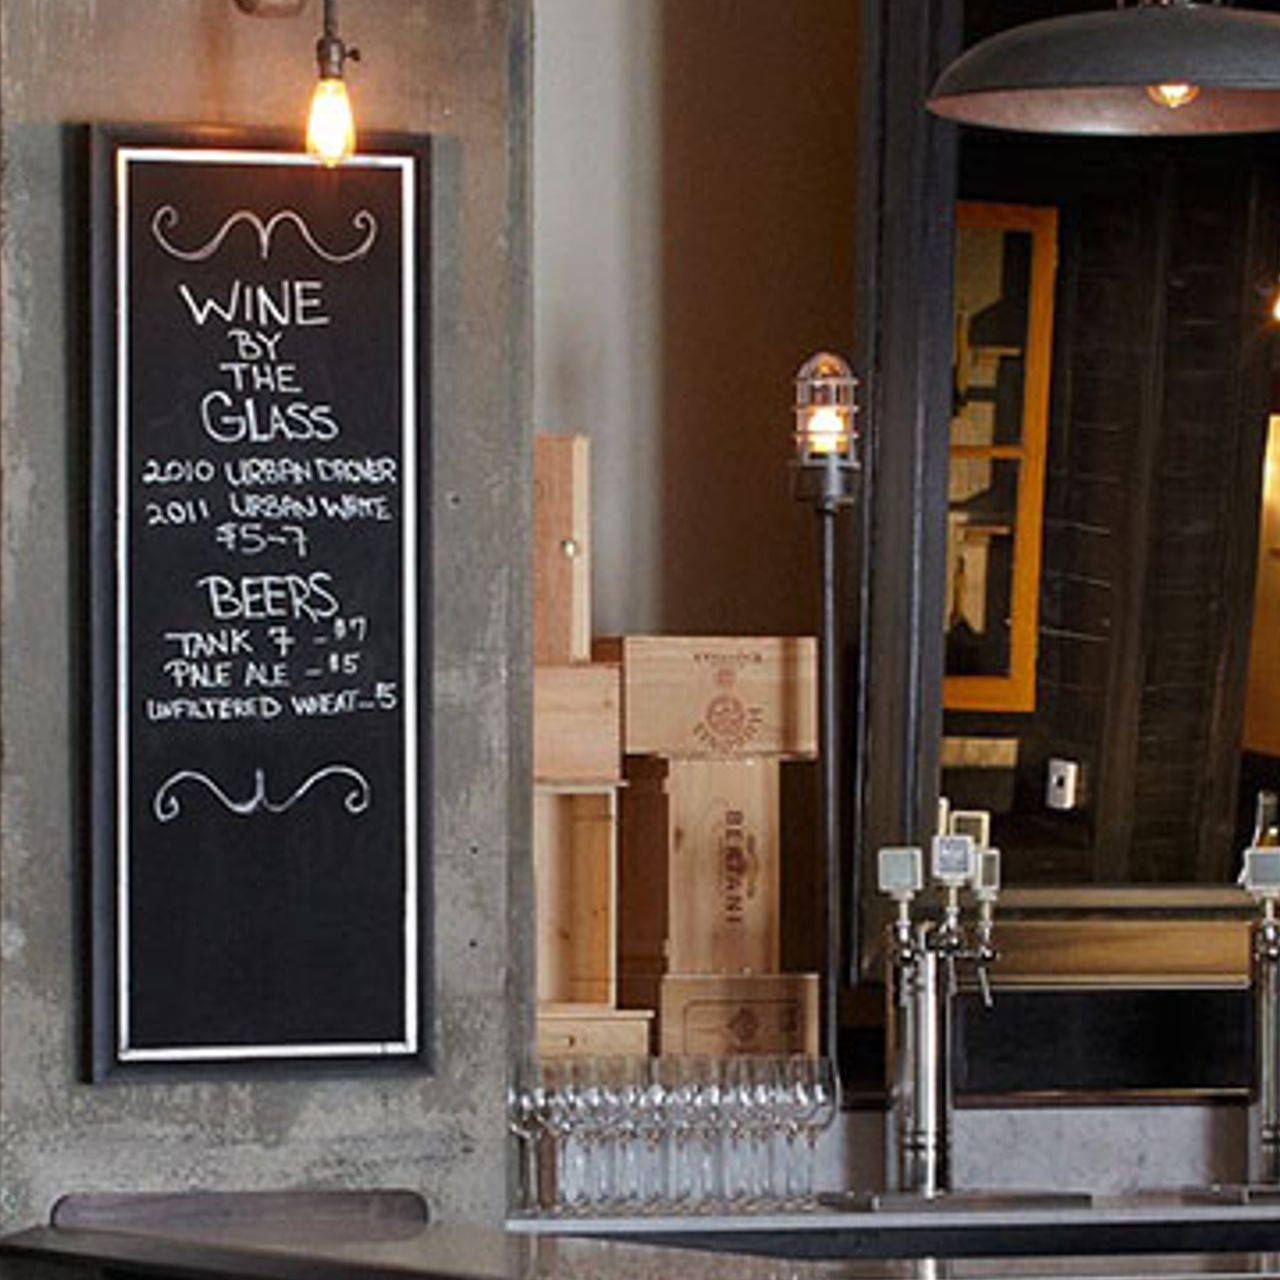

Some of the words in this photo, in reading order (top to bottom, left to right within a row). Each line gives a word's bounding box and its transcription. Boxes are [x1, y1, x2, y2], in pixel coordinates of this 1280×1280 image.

[179, 280, 330, 325] WINE
[228, 329, 282, 360] BY
[220, 364, 302, 392] THE
[201, 391, 339, 442] GLASS
[142, 459, 215, 483] 2010
[225, 458, 313, 486] URBAN
[145, 498, 210, 524] 2011
[229, 492, 318, 519] URBAN
[196, 573, 339, 622] BEERS
[165, 629, 253, 658] TANK
[269, 625, 296, 656] 7
[163, 659, 232, 687] PALE
[244, 661, 290, 687] ALE
